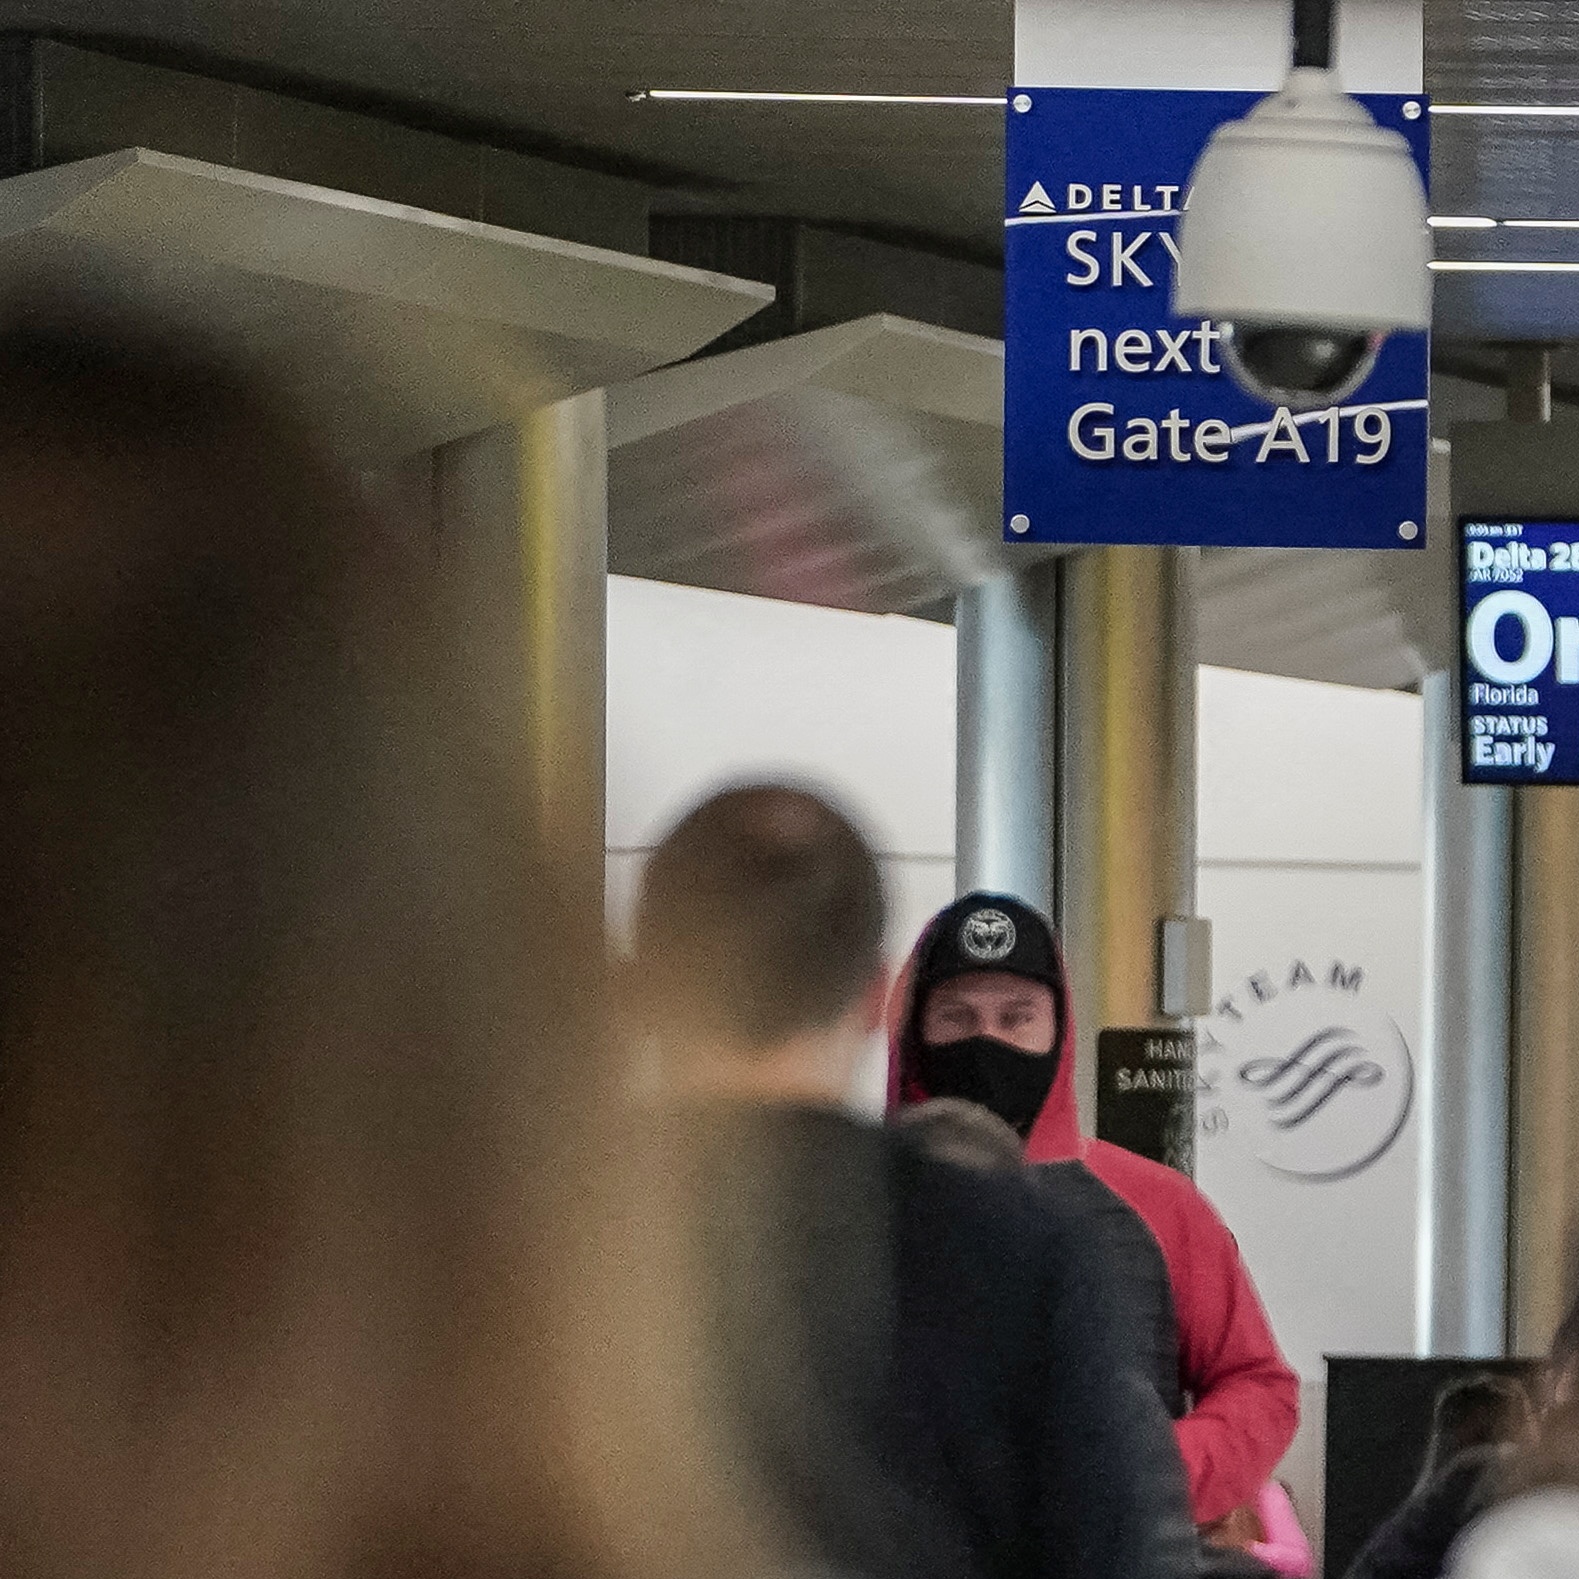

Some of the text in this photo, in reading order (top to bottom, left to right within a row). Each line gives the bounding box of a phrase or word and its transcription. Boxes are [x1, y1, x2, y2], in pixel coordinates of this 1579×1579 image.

[1067, 182, 1195, 213] DELT
[1069, 319, 1221, 374] next
[1067, 401, 1393, 467] Gate A19
[1467, 541, 1547, 571] Delta
[1471, 683, 1540, 706] Florida
[1471, 715, 1549, 736] STATUS
[1472, 735, 1556, 773] Early
[1145, 1038, 1196, 1061] HAN
